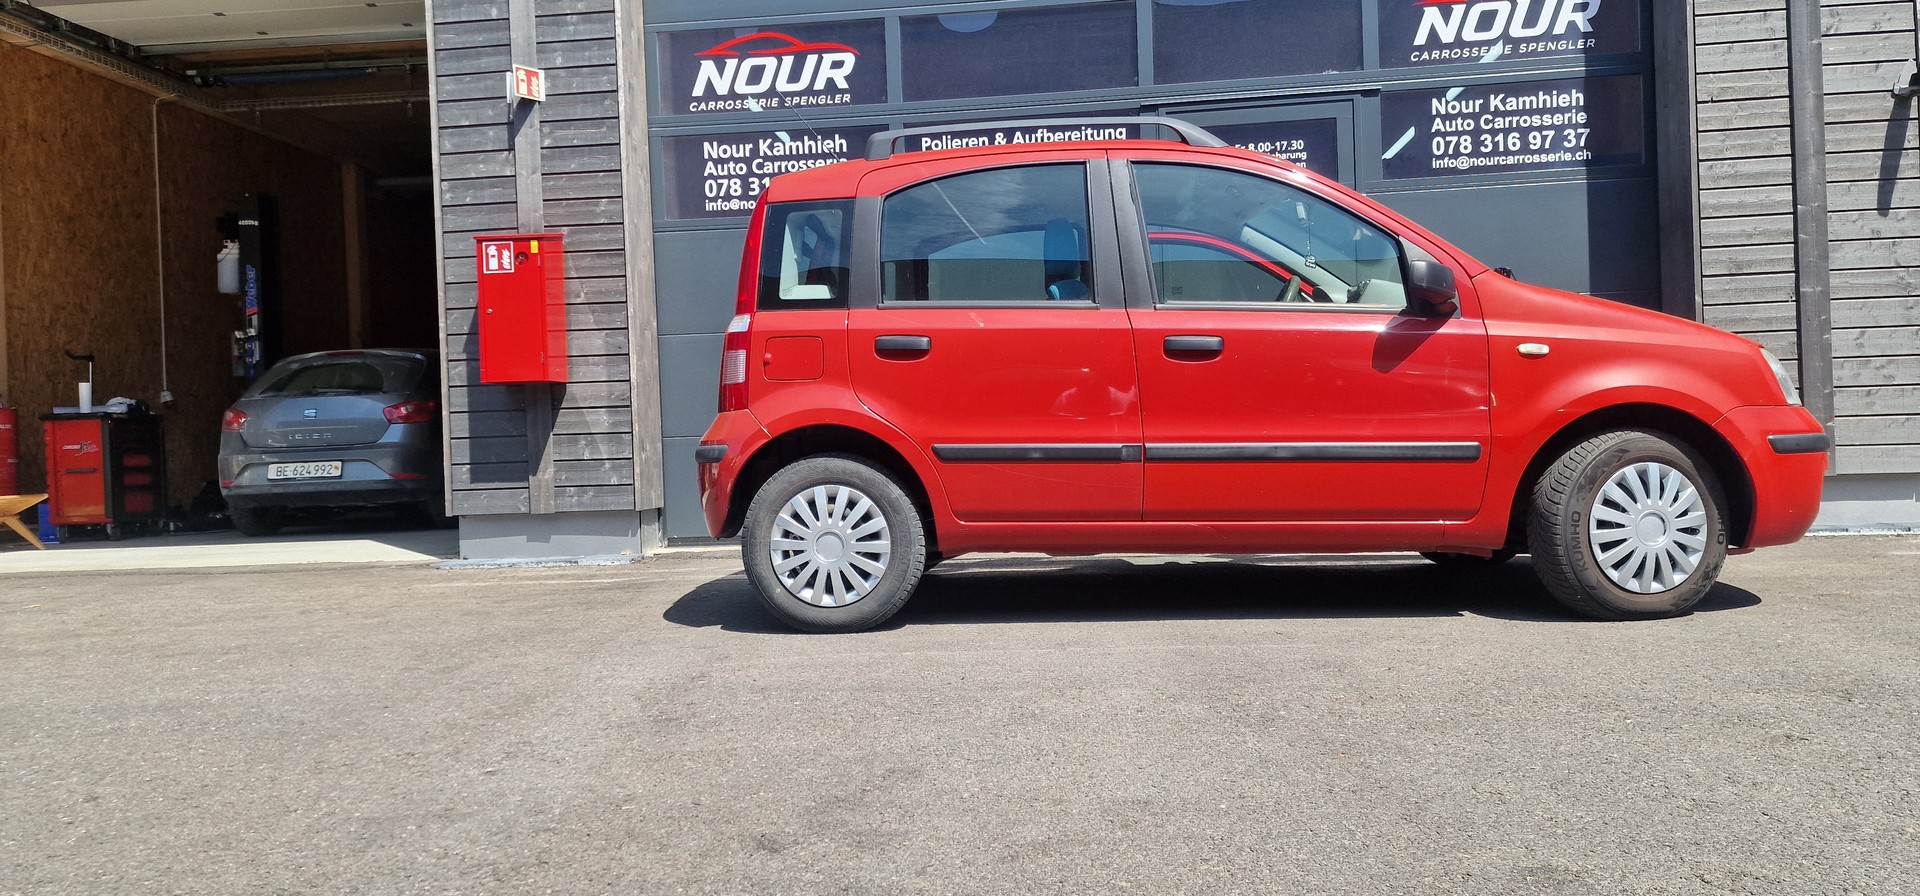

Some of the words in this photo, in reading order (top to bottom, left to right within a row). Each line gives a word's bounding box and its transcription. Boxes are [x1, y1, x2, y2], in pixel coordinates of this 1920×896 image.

[1413, 0, 1600, 46] NOUR
[1410, 44, 1513, 62] CARROSSEE
[1518, 38, 1596, 54] SPENGLER
[691, 52, 856, 97] NOUR
[784, 93, 851, 107] SPENGLER
[1431, 97, 1483, 115] Nour
[1489, 89, 1584, 112] Kamhieh
[1431, 117, 1475, 133] Auto
[1480, 110, 1588, 130] Carrosserie
[703, 141, 753, 159] Nour
[758, 134, 848, 156] Kamhieh
[921, 135, 989, 152] Polieren
[1012, 126, 1127, 145] Aufbereitung
[1432, 135, 1472, 155] 078
[1479, 133, 1521, 153] 316
[1528, 130, 1555, 149] 97
[1562, 128, 1591, 148] 37
[703, 161, 747, 176] Auto
[1432, 150, 1592, 169] info@nourcarrosserie.ch
[704, 179, 742, 197] 078
[748, 177, 771, 196] 31
[705, 200, 756, 211] info@no
[246, 265, 257, 309] Weber
[1570, 510, 1588, 573] KUMHO
